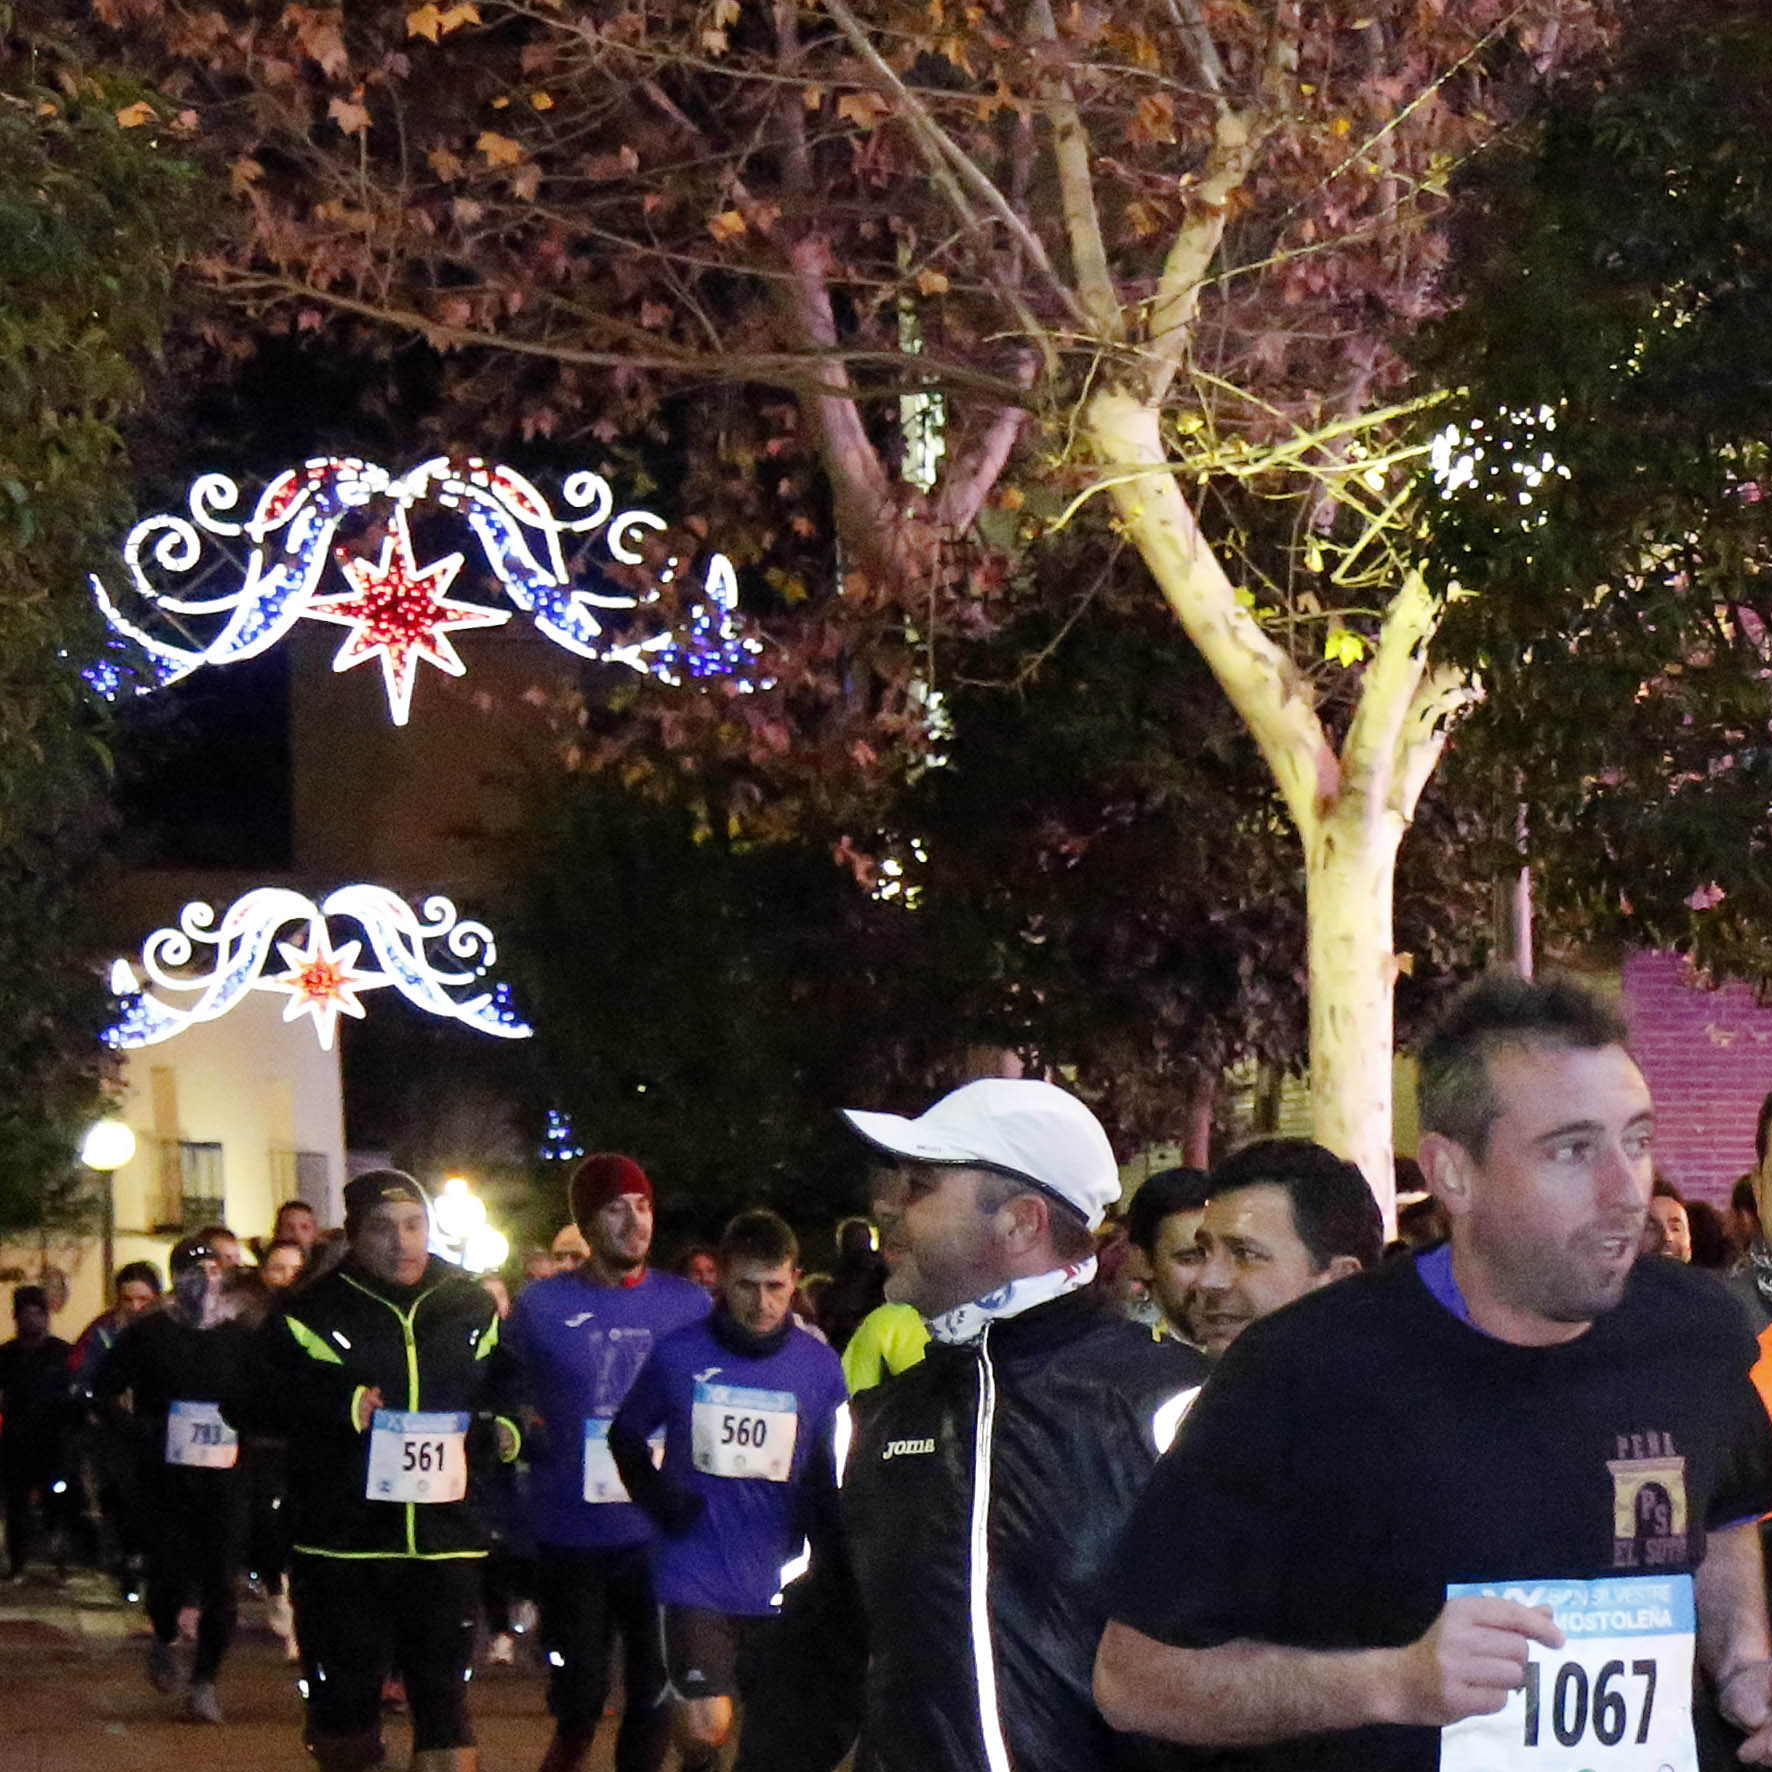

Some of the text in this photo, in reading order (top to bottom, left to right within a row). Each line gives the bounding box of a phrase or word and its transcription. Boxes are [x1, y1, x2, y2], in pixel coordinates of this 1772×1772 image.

[721, 1414, 767, 1448] 560
[402, 1441, 445, 1472] 561
[1516, 1658, 1658, 1749] 1067
